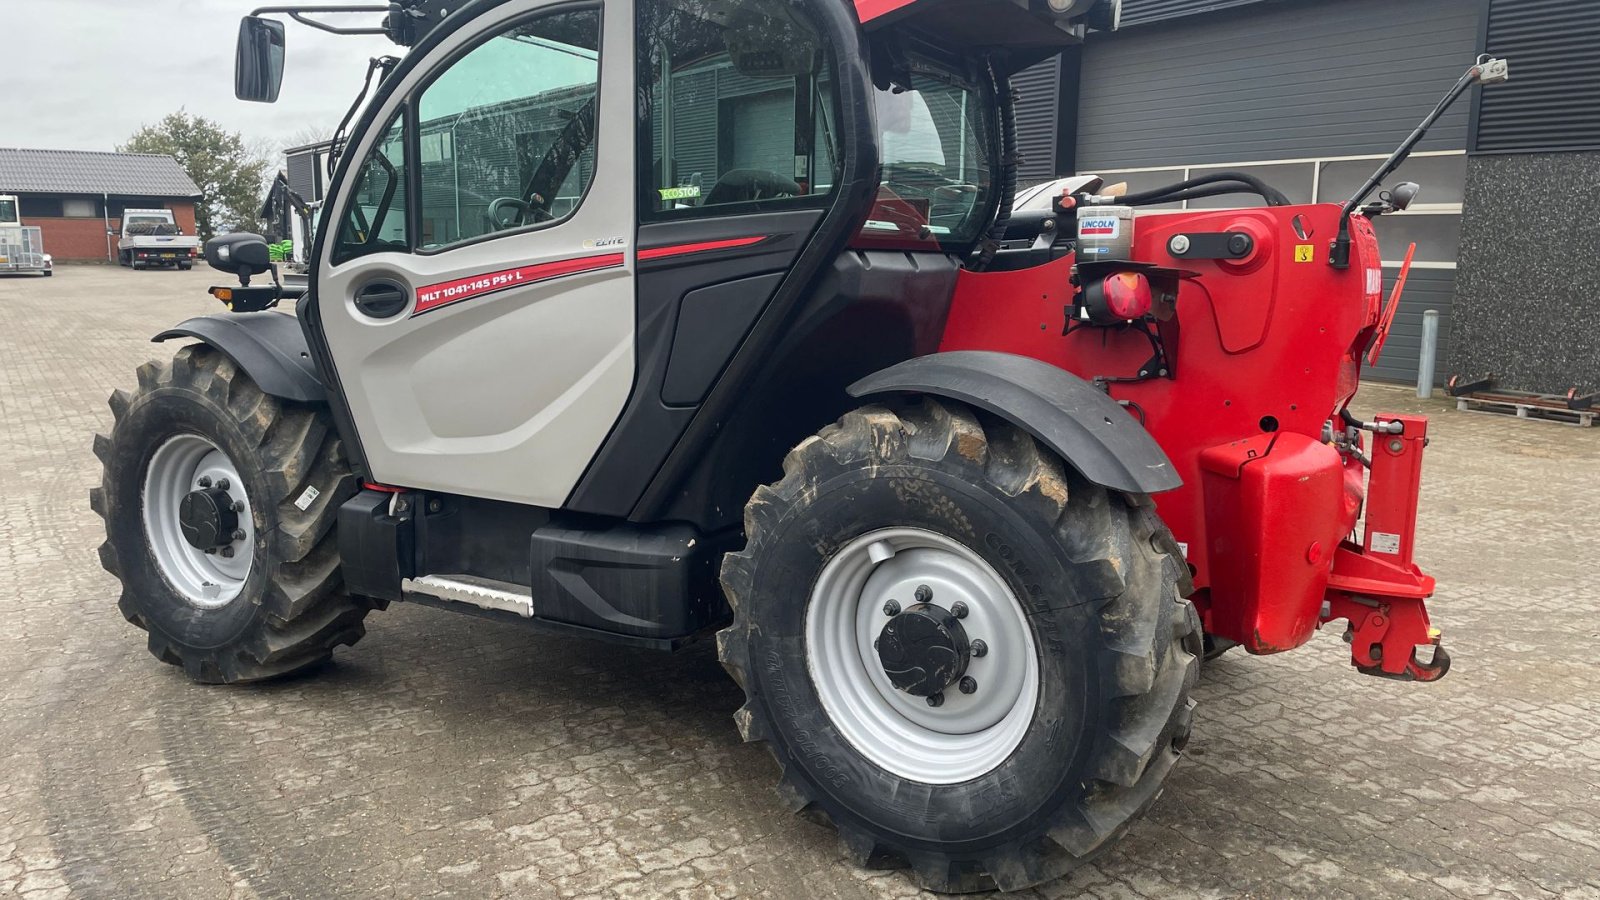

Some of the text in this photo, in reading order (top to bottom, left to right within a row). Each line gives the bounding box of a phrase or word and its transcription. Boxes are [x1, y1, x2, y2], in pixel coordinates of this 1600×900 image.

[663, 186, 699, 199] ECOSTOP
[1081, 220, 1115, 228] LINCOLN
[421, 271, 523, 302] MLT 1041-145 PS+ L
